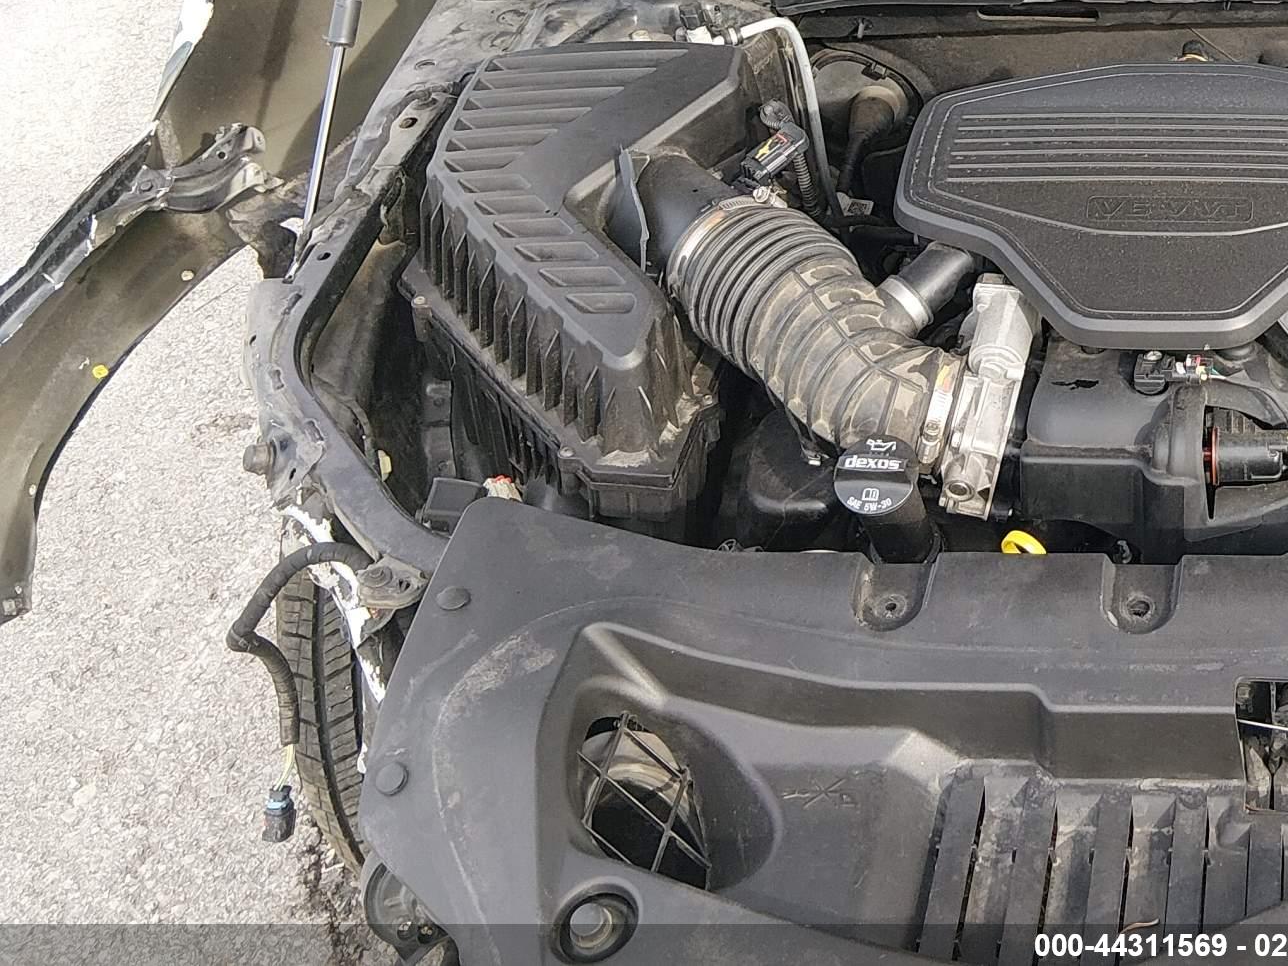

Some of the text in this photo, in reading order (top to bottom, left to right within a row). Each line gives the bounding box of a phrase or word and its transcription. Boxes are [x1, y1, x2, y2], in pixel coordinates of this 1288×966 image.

[845, 455, 902, 470] dexos
[846, 496, 892, 511] SAE 5W-30
